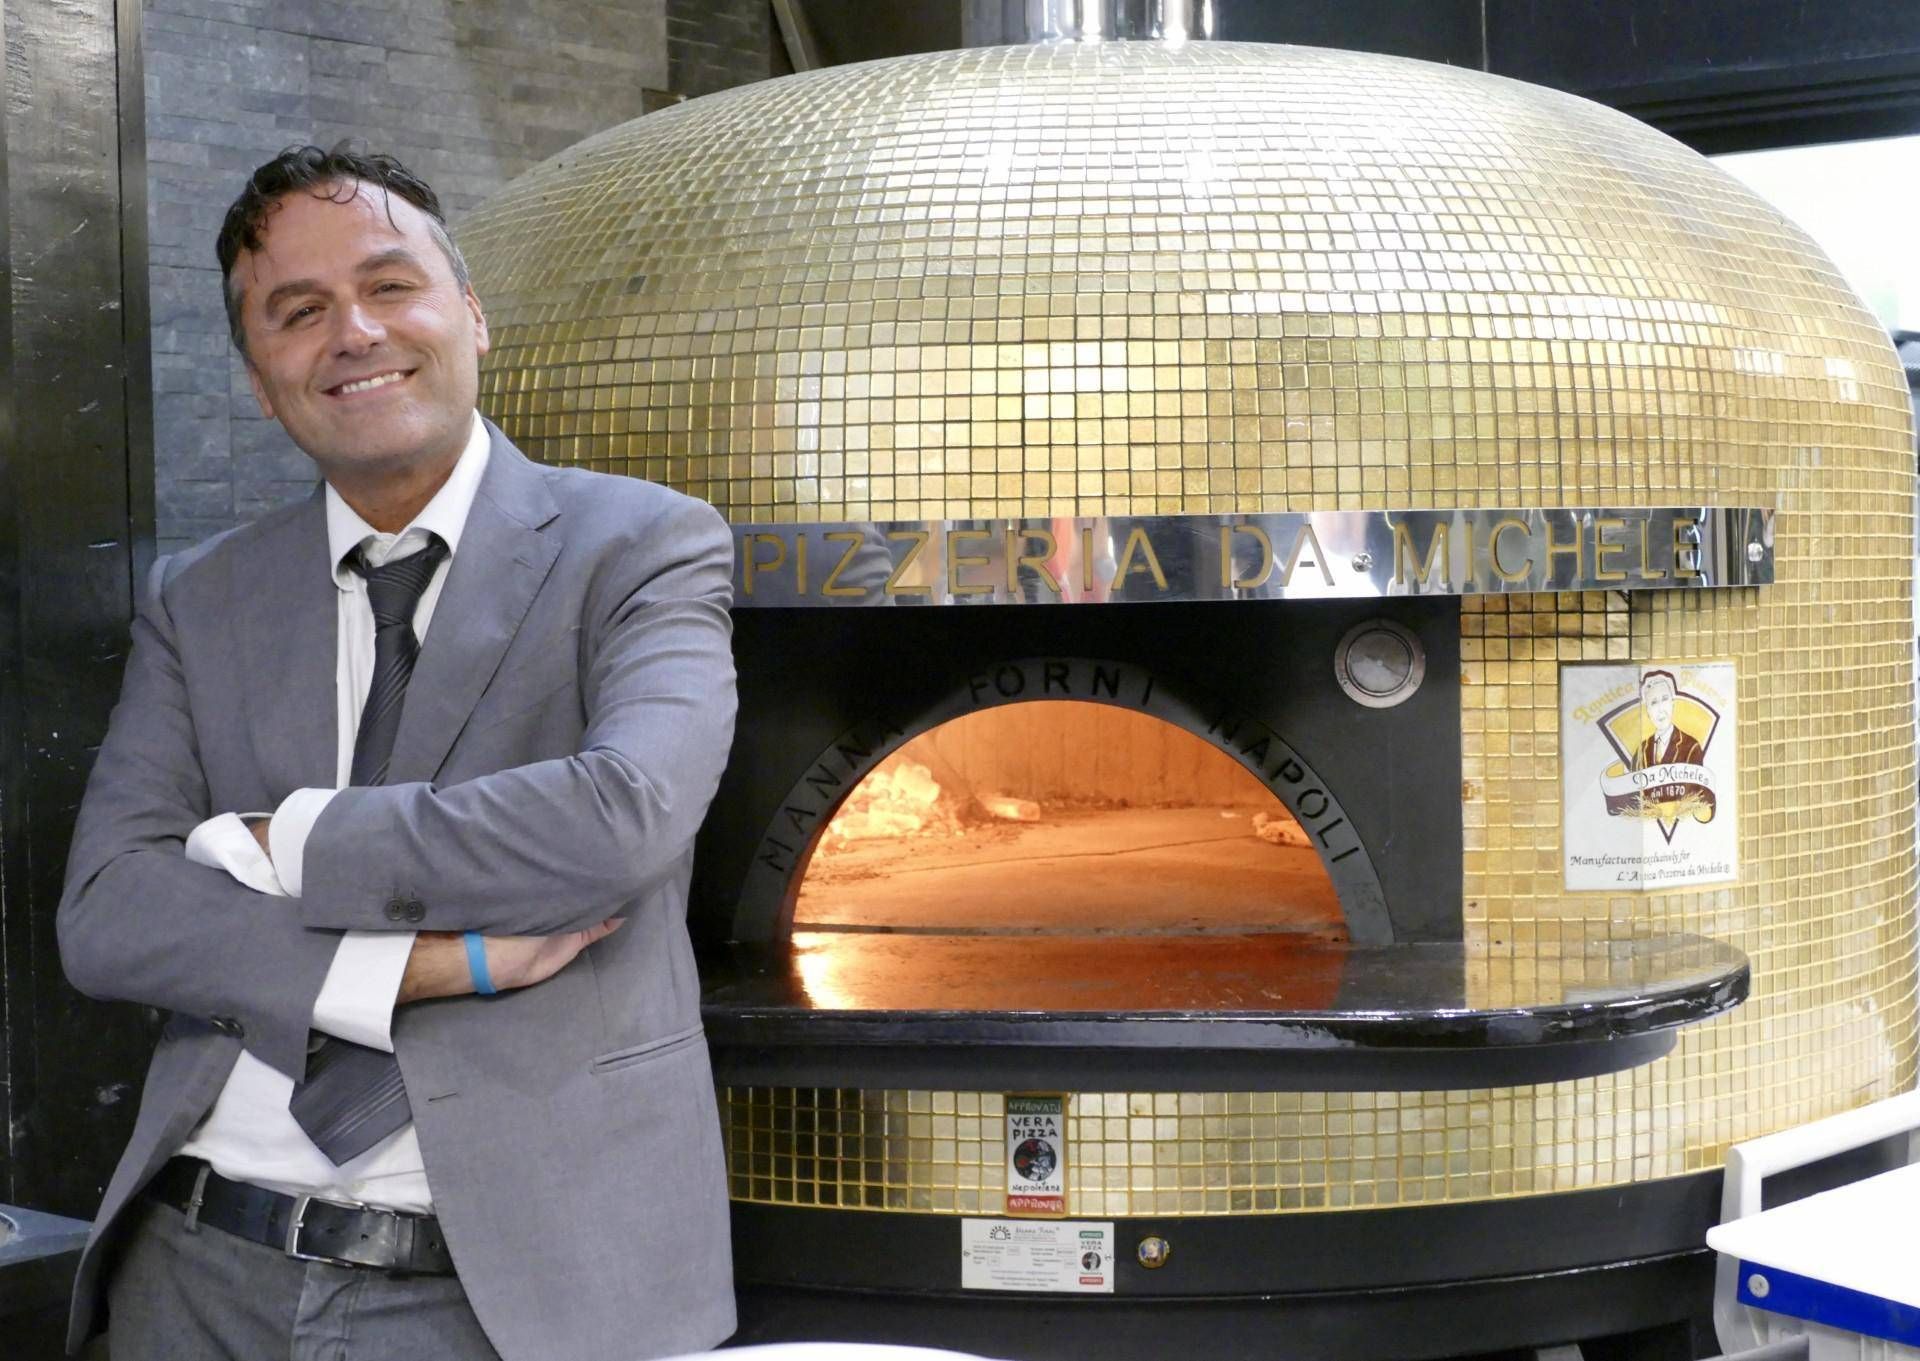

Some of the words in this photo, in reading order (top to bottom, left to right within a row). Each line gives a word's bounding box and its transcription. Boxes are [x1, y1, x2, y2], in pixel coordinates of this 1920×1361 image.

[743, 526, 1168, 596] PIZZERIA
[1221, 524, 1335, 589] DA
[1395, 517, 1702, 586] MICHELE
[968, 661, 1155, 707] FORNI
[1208, 714, 1361, 864] NAPOLI
[1632, 771, 1655, 788] Da
[1659, 765, 1704, 783] Michele
[1011, 1116, 1055, 1127] VERA
[1013, 1128, 1058, 1140] PIZZA
